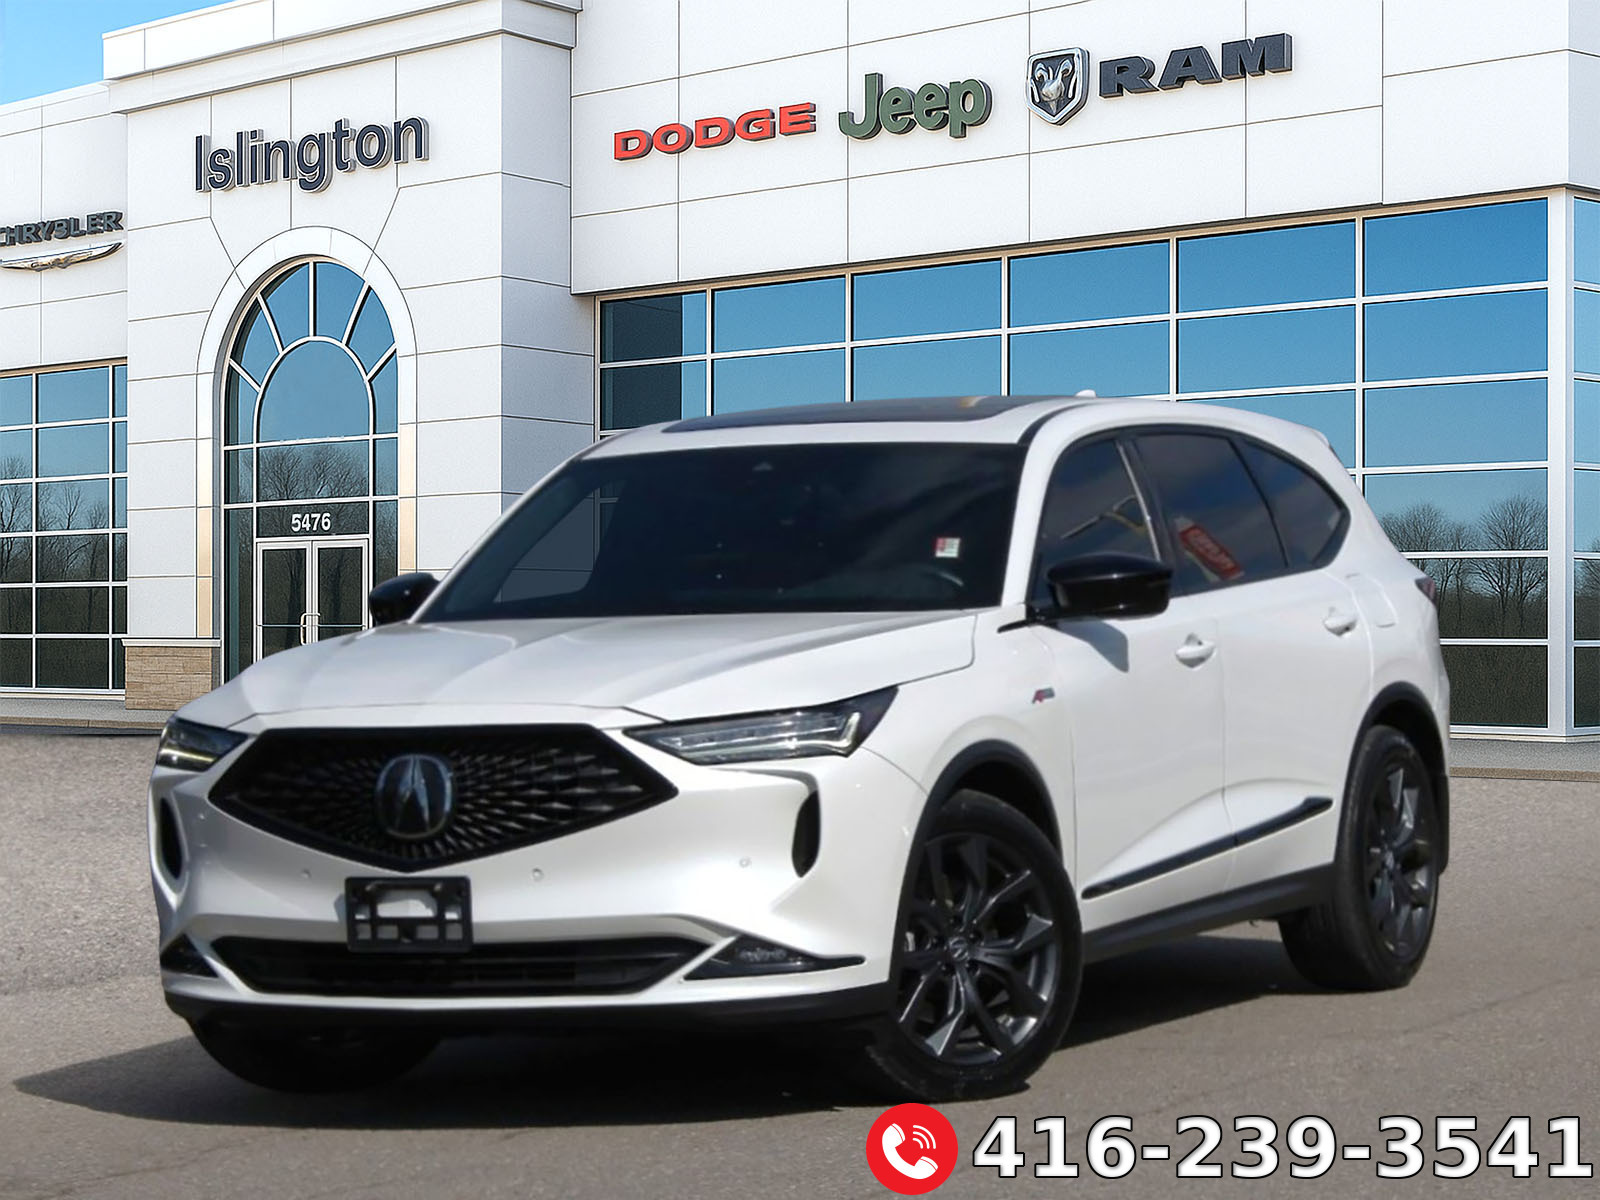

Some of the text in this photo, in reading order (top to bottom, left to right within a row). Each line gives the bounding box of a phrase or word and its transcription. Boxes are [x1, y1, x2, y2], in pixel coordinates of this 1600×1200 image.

[613, 33, 1293, 161] DODGE Jeep RAM
[194, 116, 430, 193] Islington
[291, 512, 331, 532] 5476
